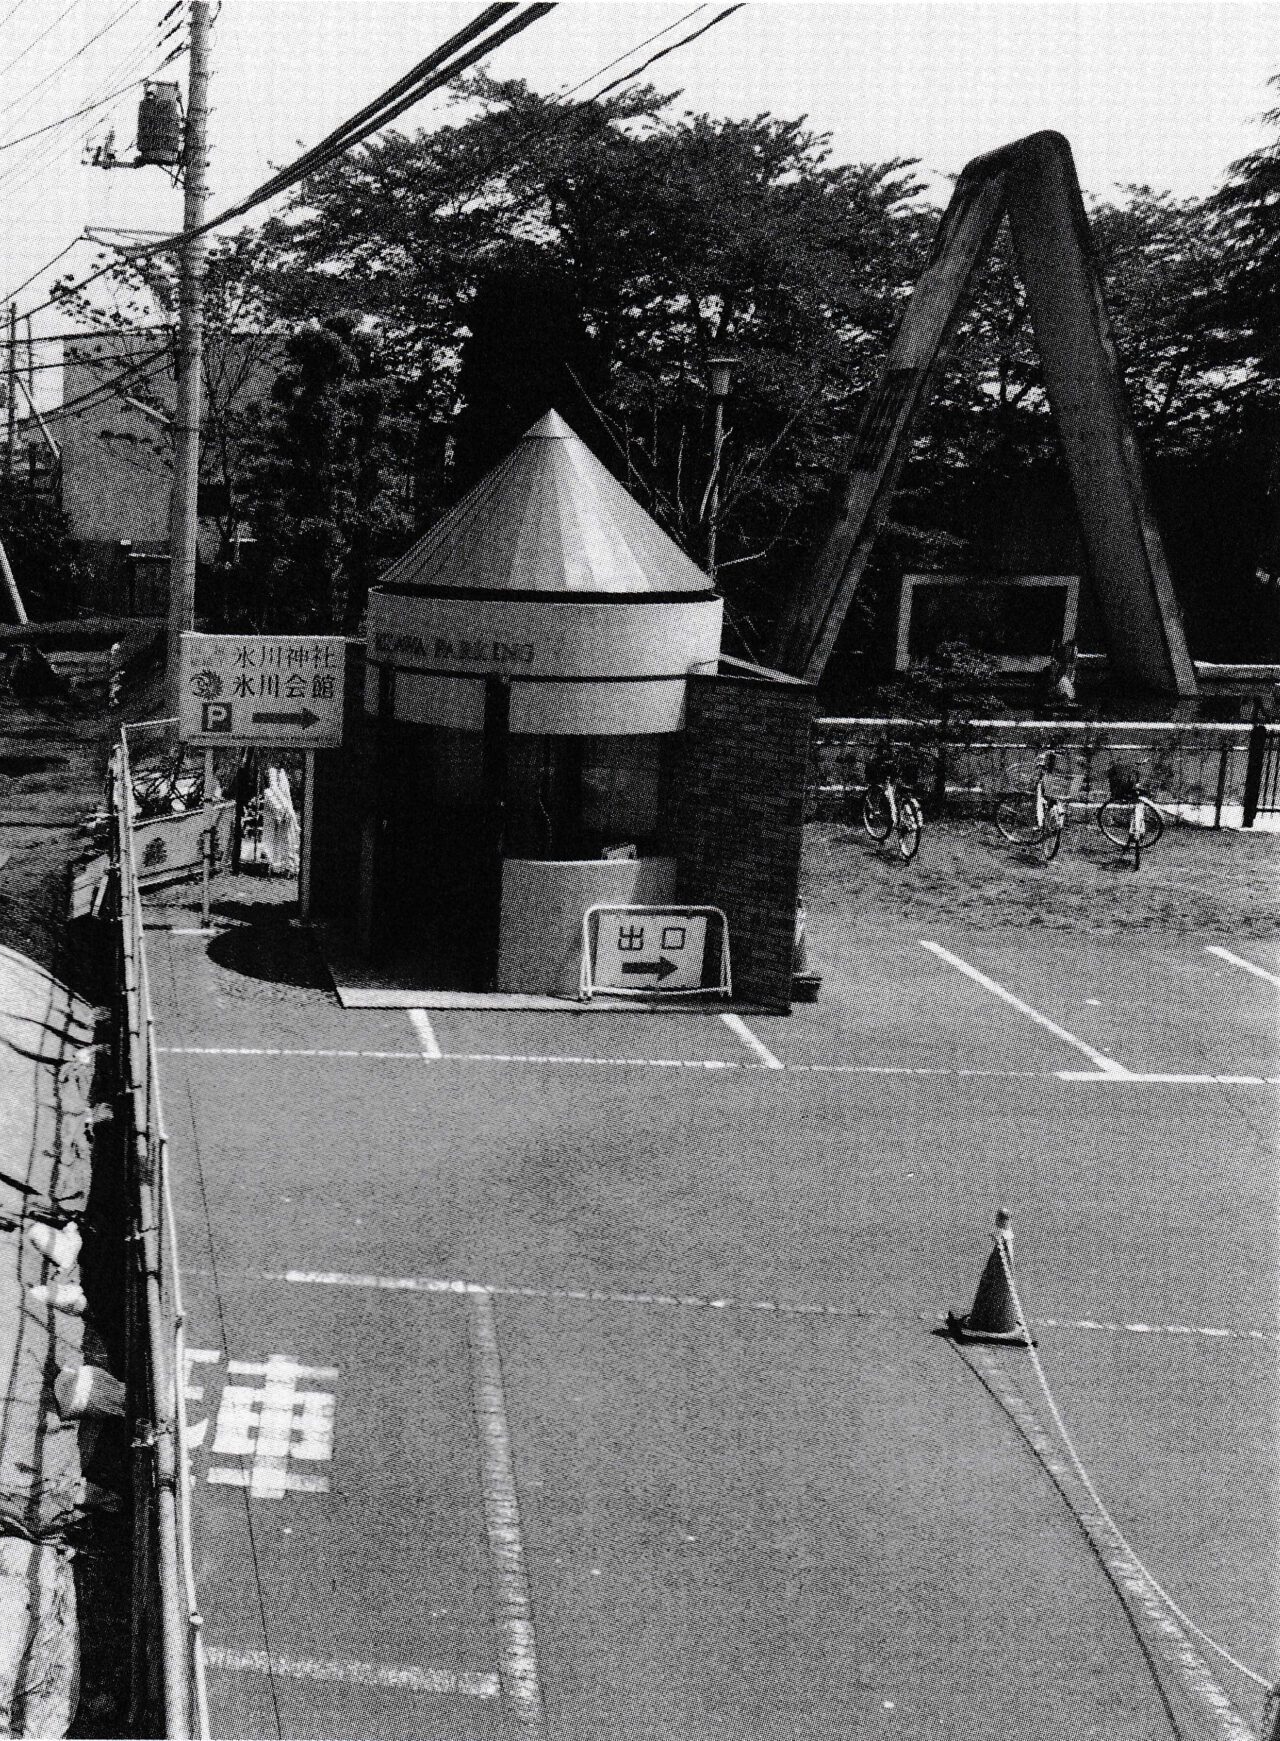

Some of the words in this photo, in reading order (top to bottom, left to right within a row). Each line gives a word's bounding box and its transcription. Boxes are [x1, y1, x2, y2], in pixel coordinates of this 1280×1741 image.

[232, 645, 337, 669] 氷川神社
[232, 672, 336, 699] 氷川会館
[206, 704, 228, 731] P
[617, 924, 687, 951] 出口
